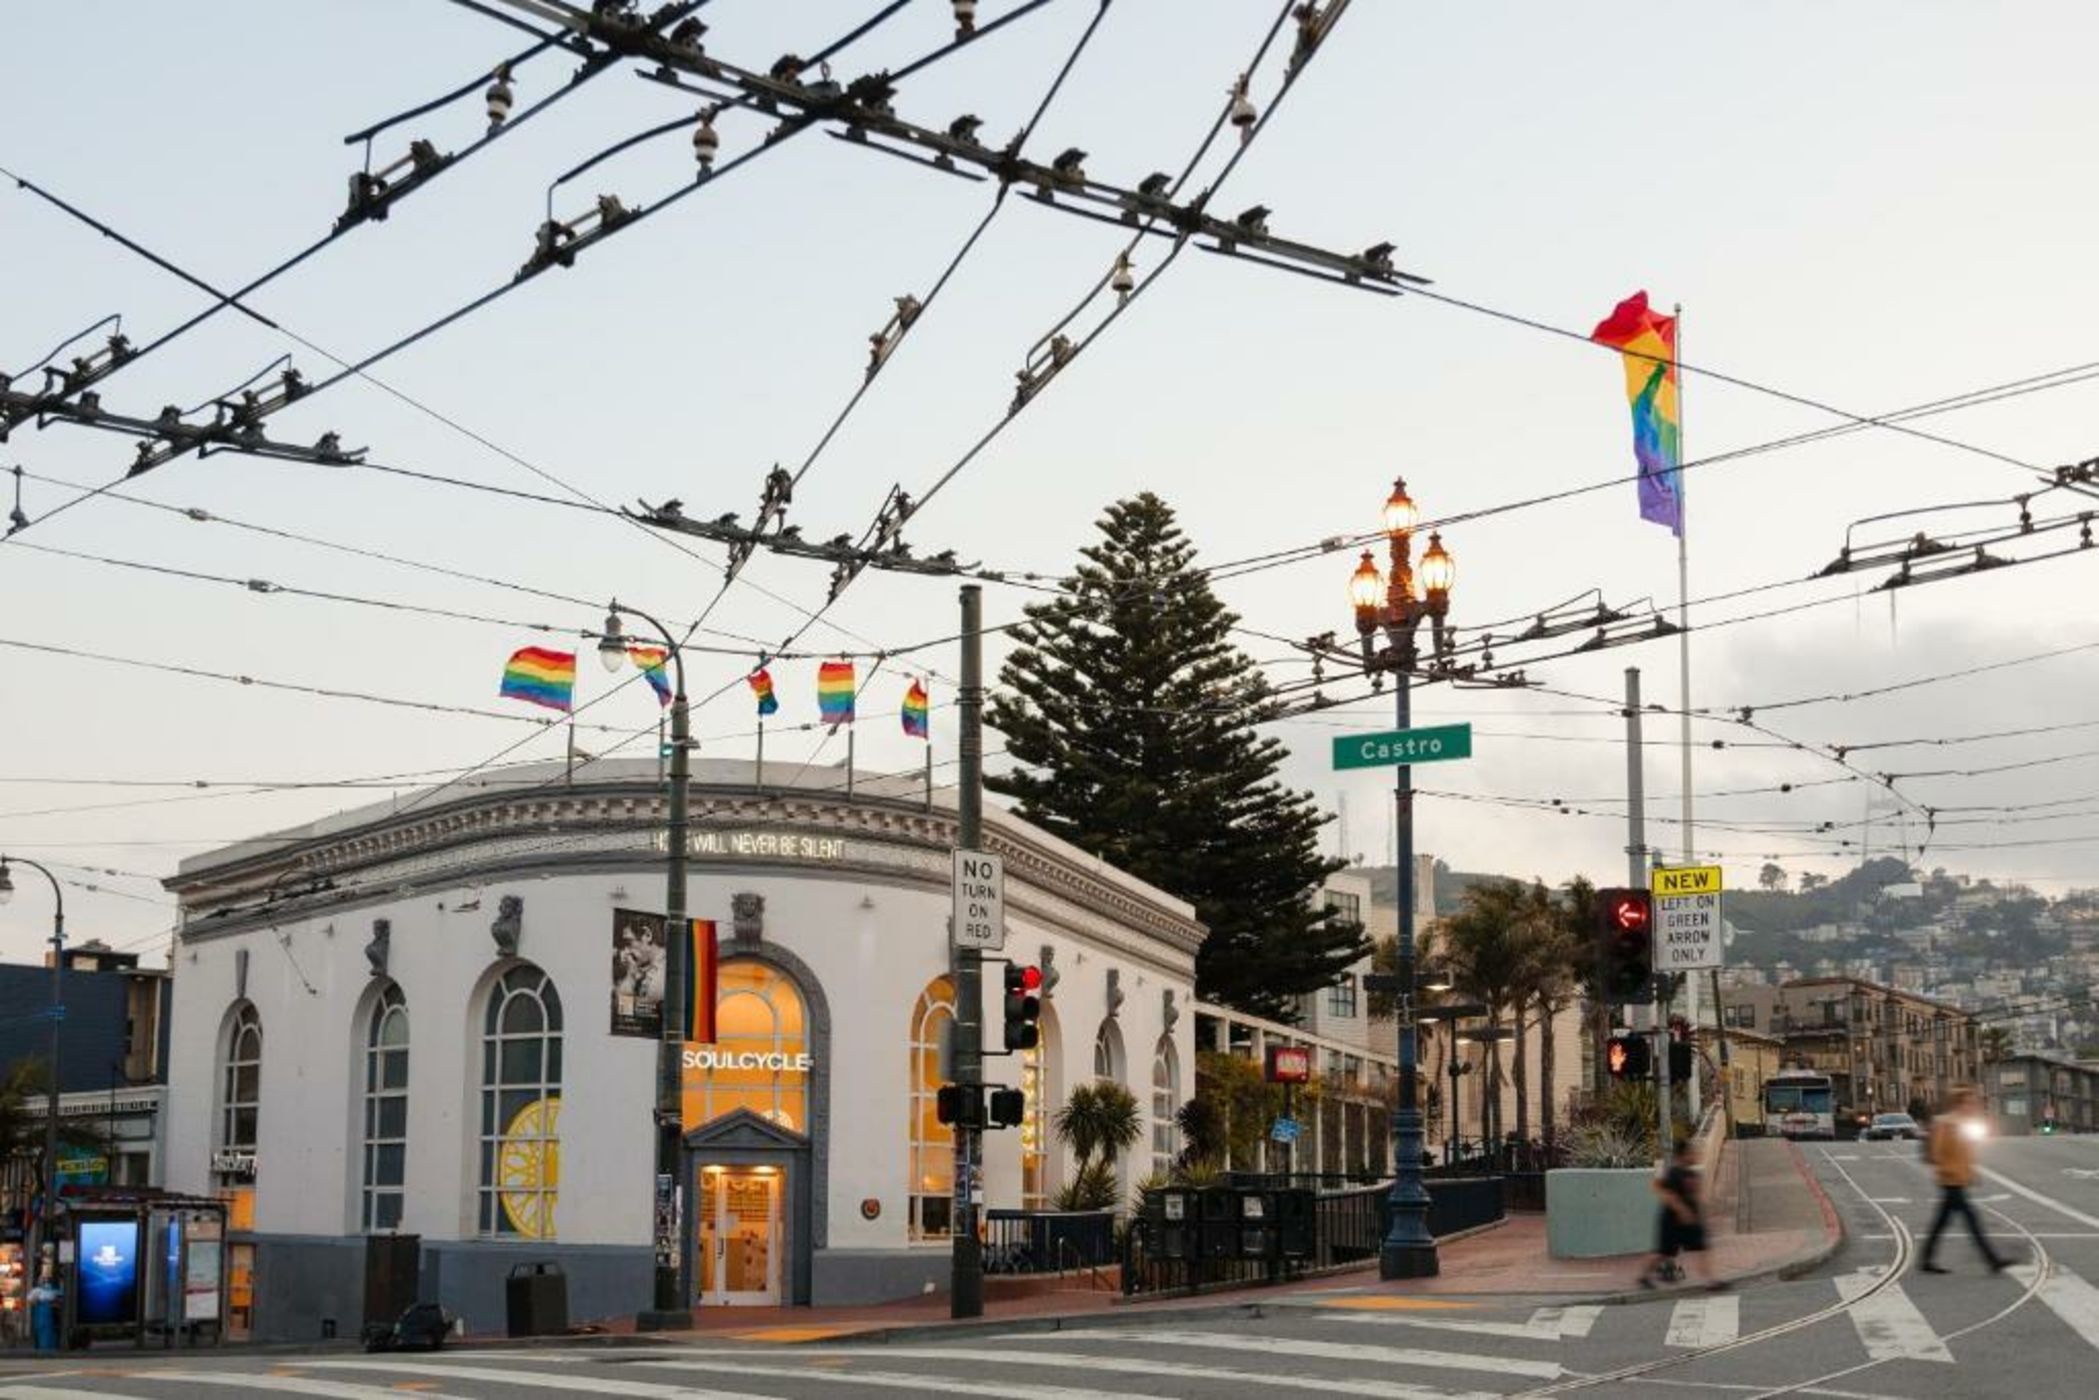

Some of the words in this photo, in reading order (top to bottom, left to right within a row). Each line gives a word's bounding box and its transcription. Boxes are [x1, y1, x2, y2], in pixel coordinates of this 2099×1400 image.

[1361, 738, 1442, 759] Castro
[694, 831, 728, 853] WILL
[731, 833, 778, 855] NEVER
[780, 835, 798, 856] BE
[800, 837, 845, 858] SILENT
[963, 860, 993, 880] NO
[1664, 872, 1709, 889] NEW
[961, 883, 996, 899] TURN
[969, 903, 988, 918] ON
[1662, 896, 1690, 910] LEFT
[1696, 895, 1714, 909] ON
[1667, 912, 1709, 927] GREEN
[966, 923, 991, 939] RED
[1667, 930, 1710, 944] ARROW
[1672, 948, 1705, 962] ONLY
[682, 1050, 810, 1071] SOULCYCLE
